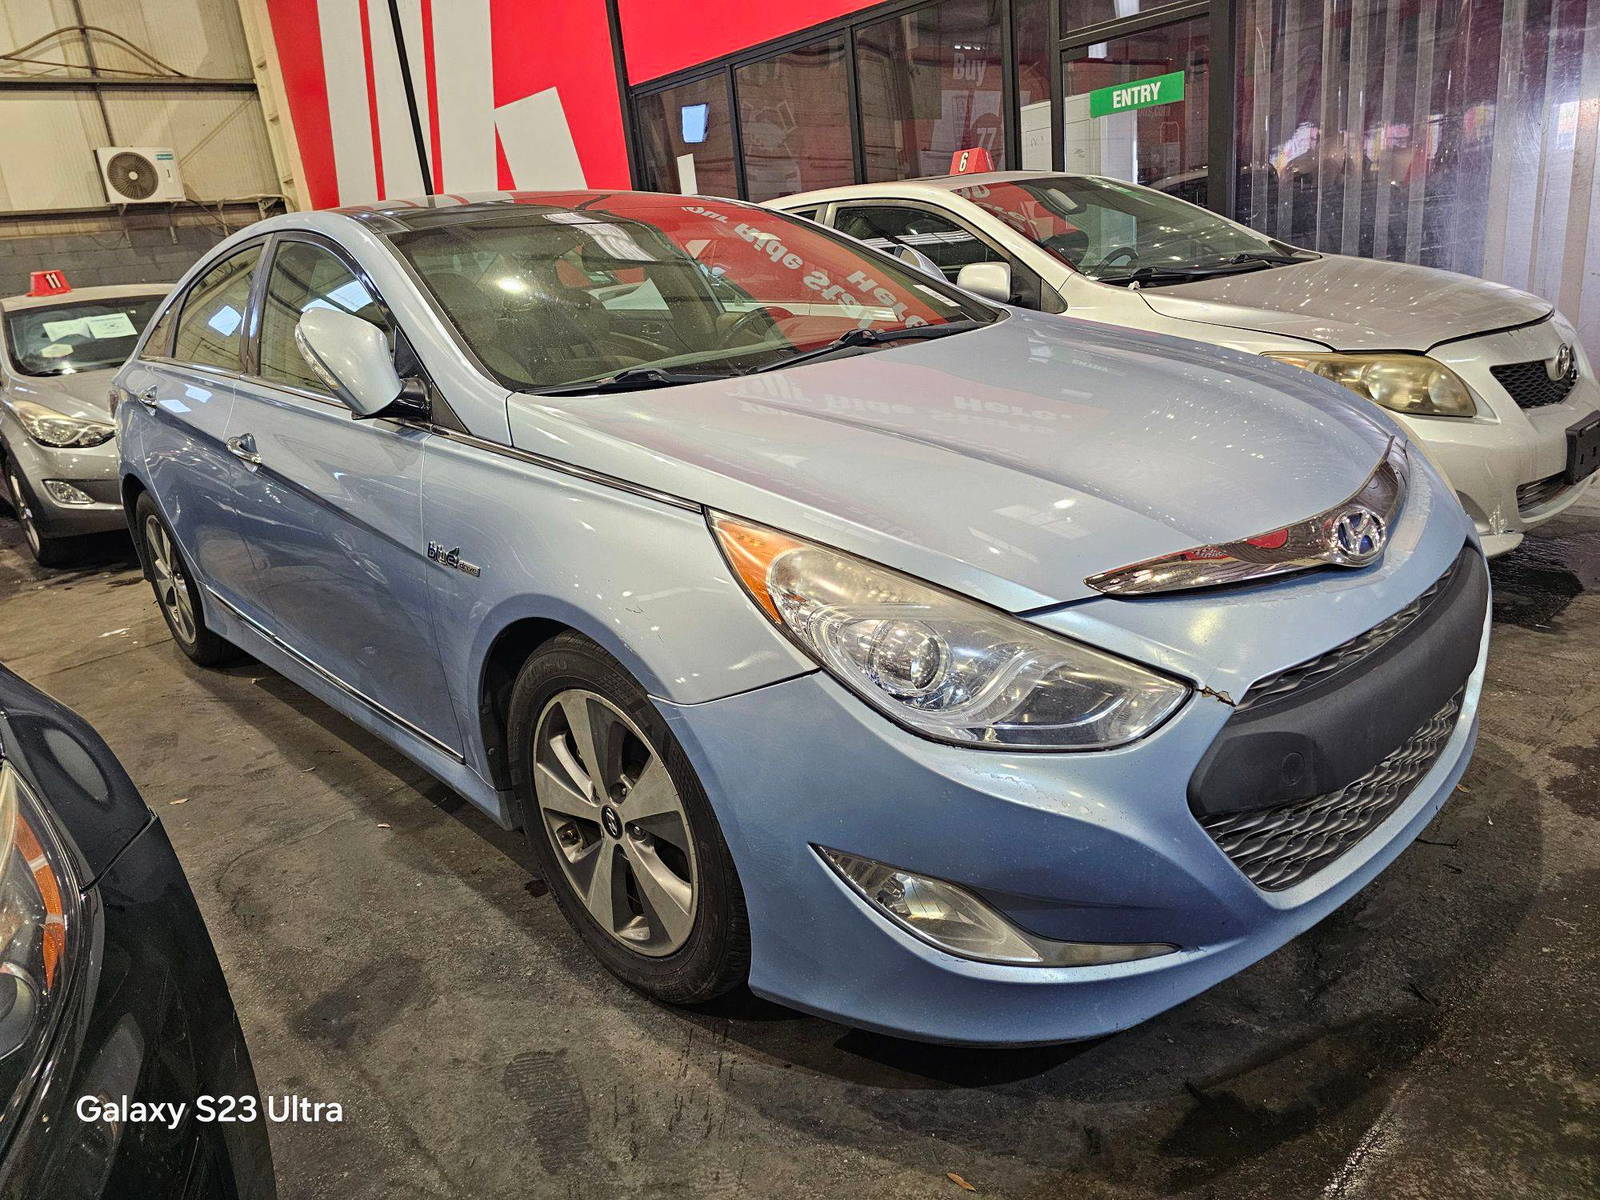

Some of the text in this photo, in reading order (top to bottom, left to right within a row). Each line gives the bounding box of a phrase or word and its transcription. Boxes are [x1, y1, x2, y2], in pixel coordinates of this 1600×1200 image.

[952, 53, 987, 87] Buy
[1112, 81, 1162, 109] ENTRY
[959, 151, 969, 172] 6
[45, 272, 62, 289] 11
